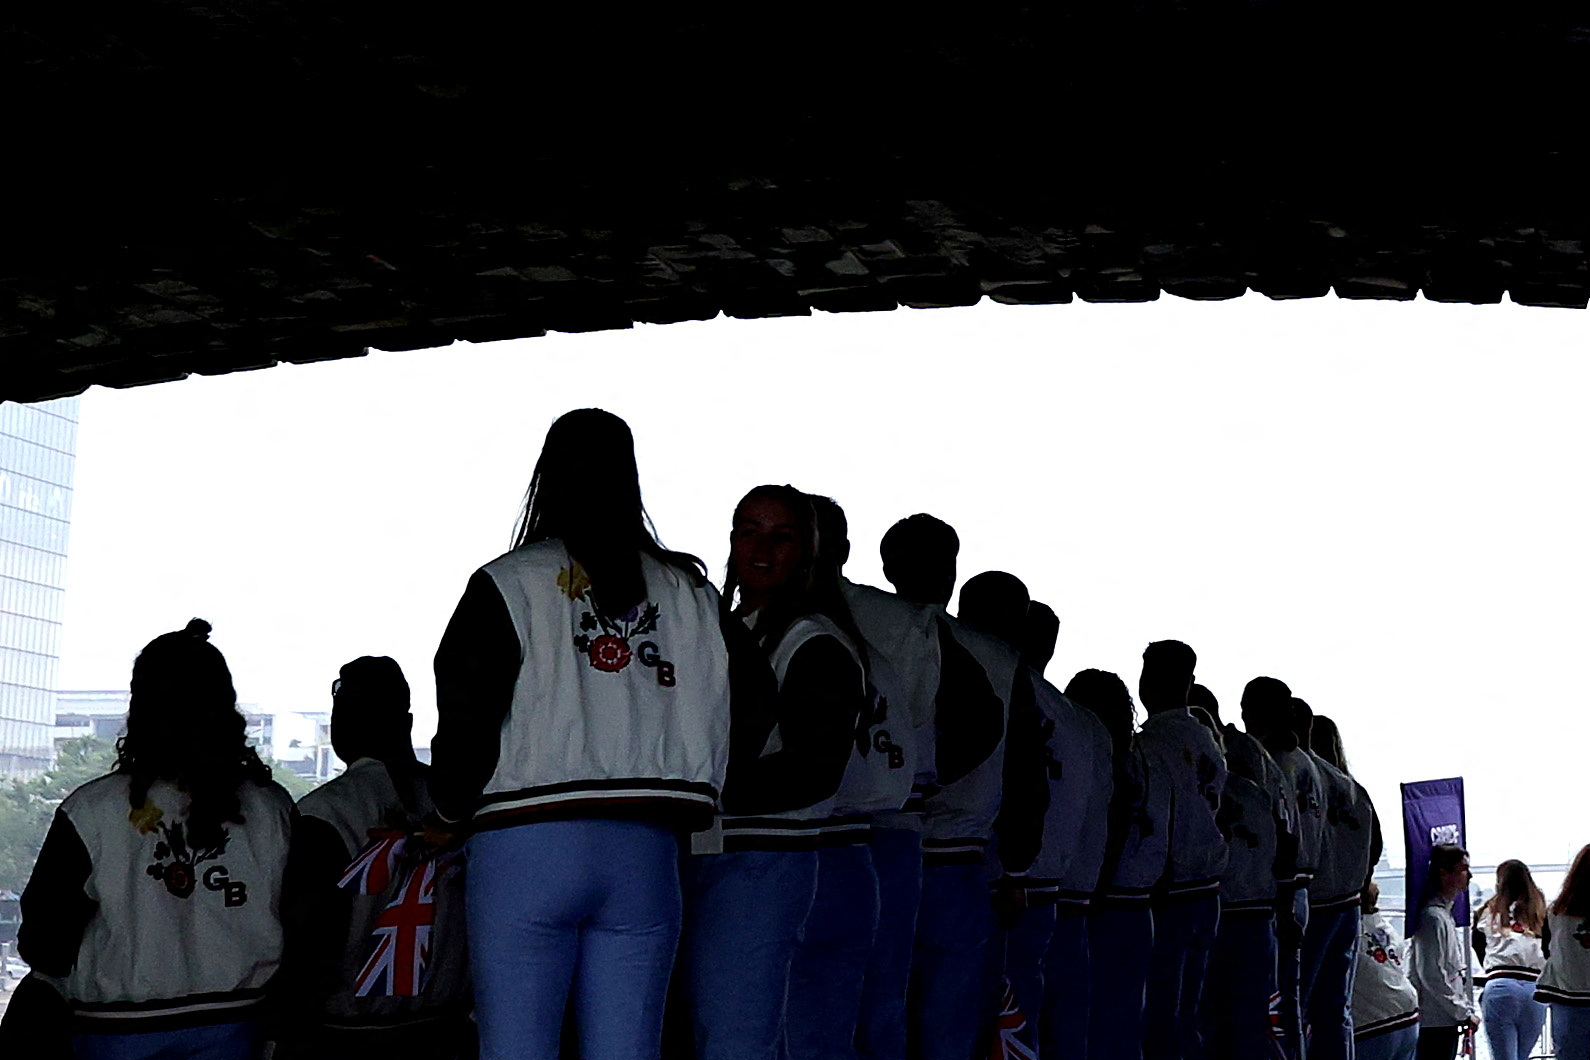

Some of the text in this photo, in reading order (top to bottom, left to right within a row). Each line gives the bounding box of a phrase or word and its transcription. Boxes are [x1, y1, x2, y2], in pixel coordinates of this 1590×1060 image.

[637, 640, 676, 687] GB
[874, 730, 904, 769] GB
[203, 866, 247, 907] GB
